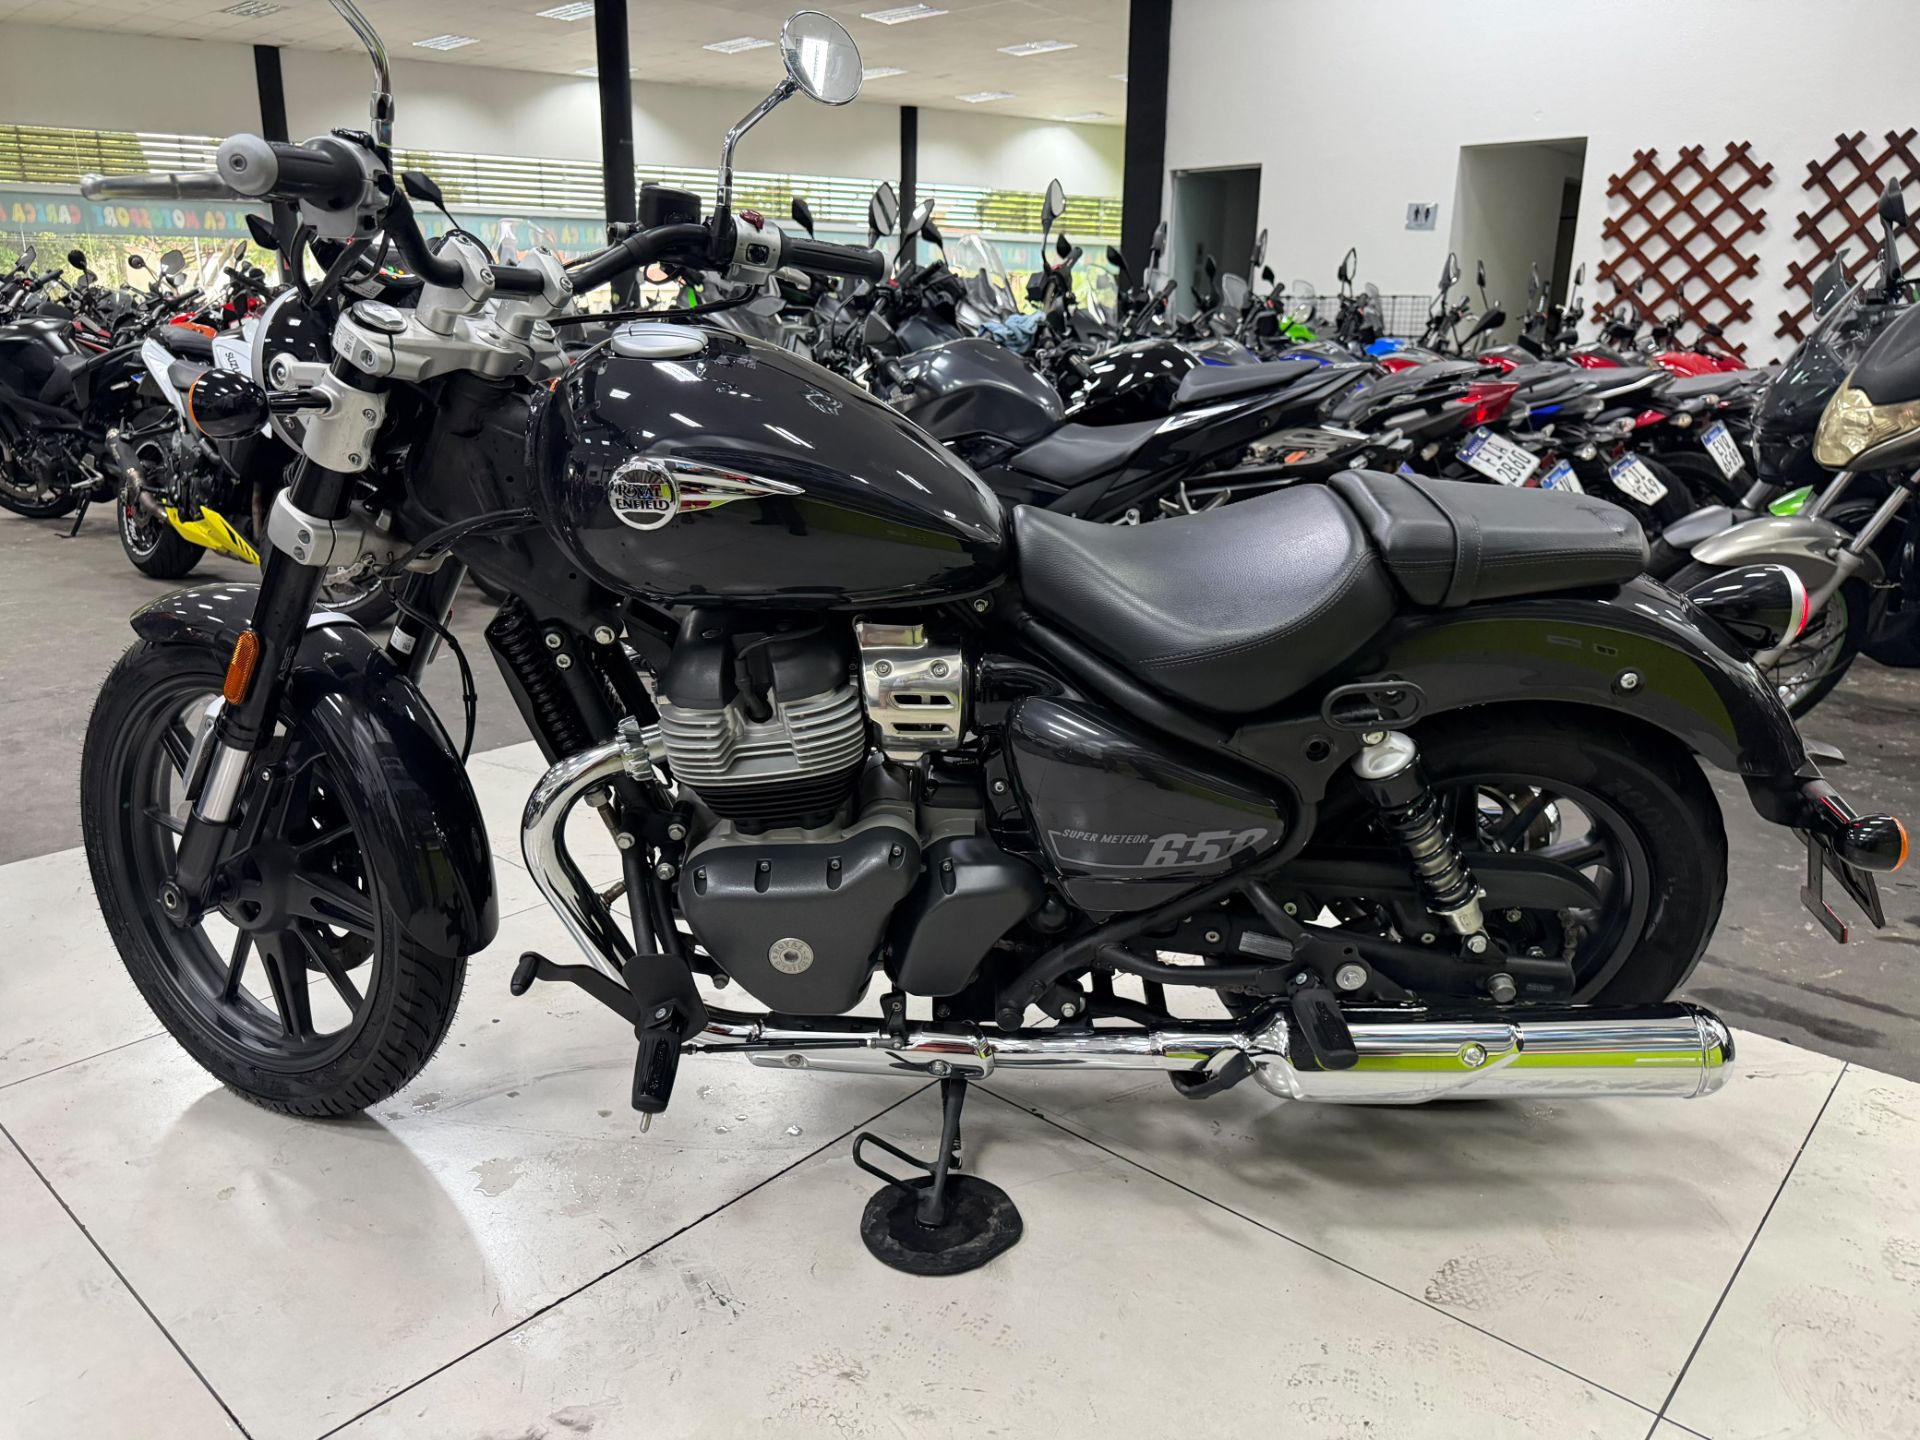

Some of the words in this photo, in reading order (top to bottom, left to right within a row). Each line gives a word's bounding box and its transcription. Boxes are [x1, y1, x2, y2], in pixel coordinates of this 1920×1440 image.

[1496, 449, 1532, 483] 2B60
[616, 484, 661, 499] ROYAL
[615, 499, 670, 511] ENFIELD
[1061, 828, 1099, 843] SUPER
[1099, 833, 1149, 845] METEOR
